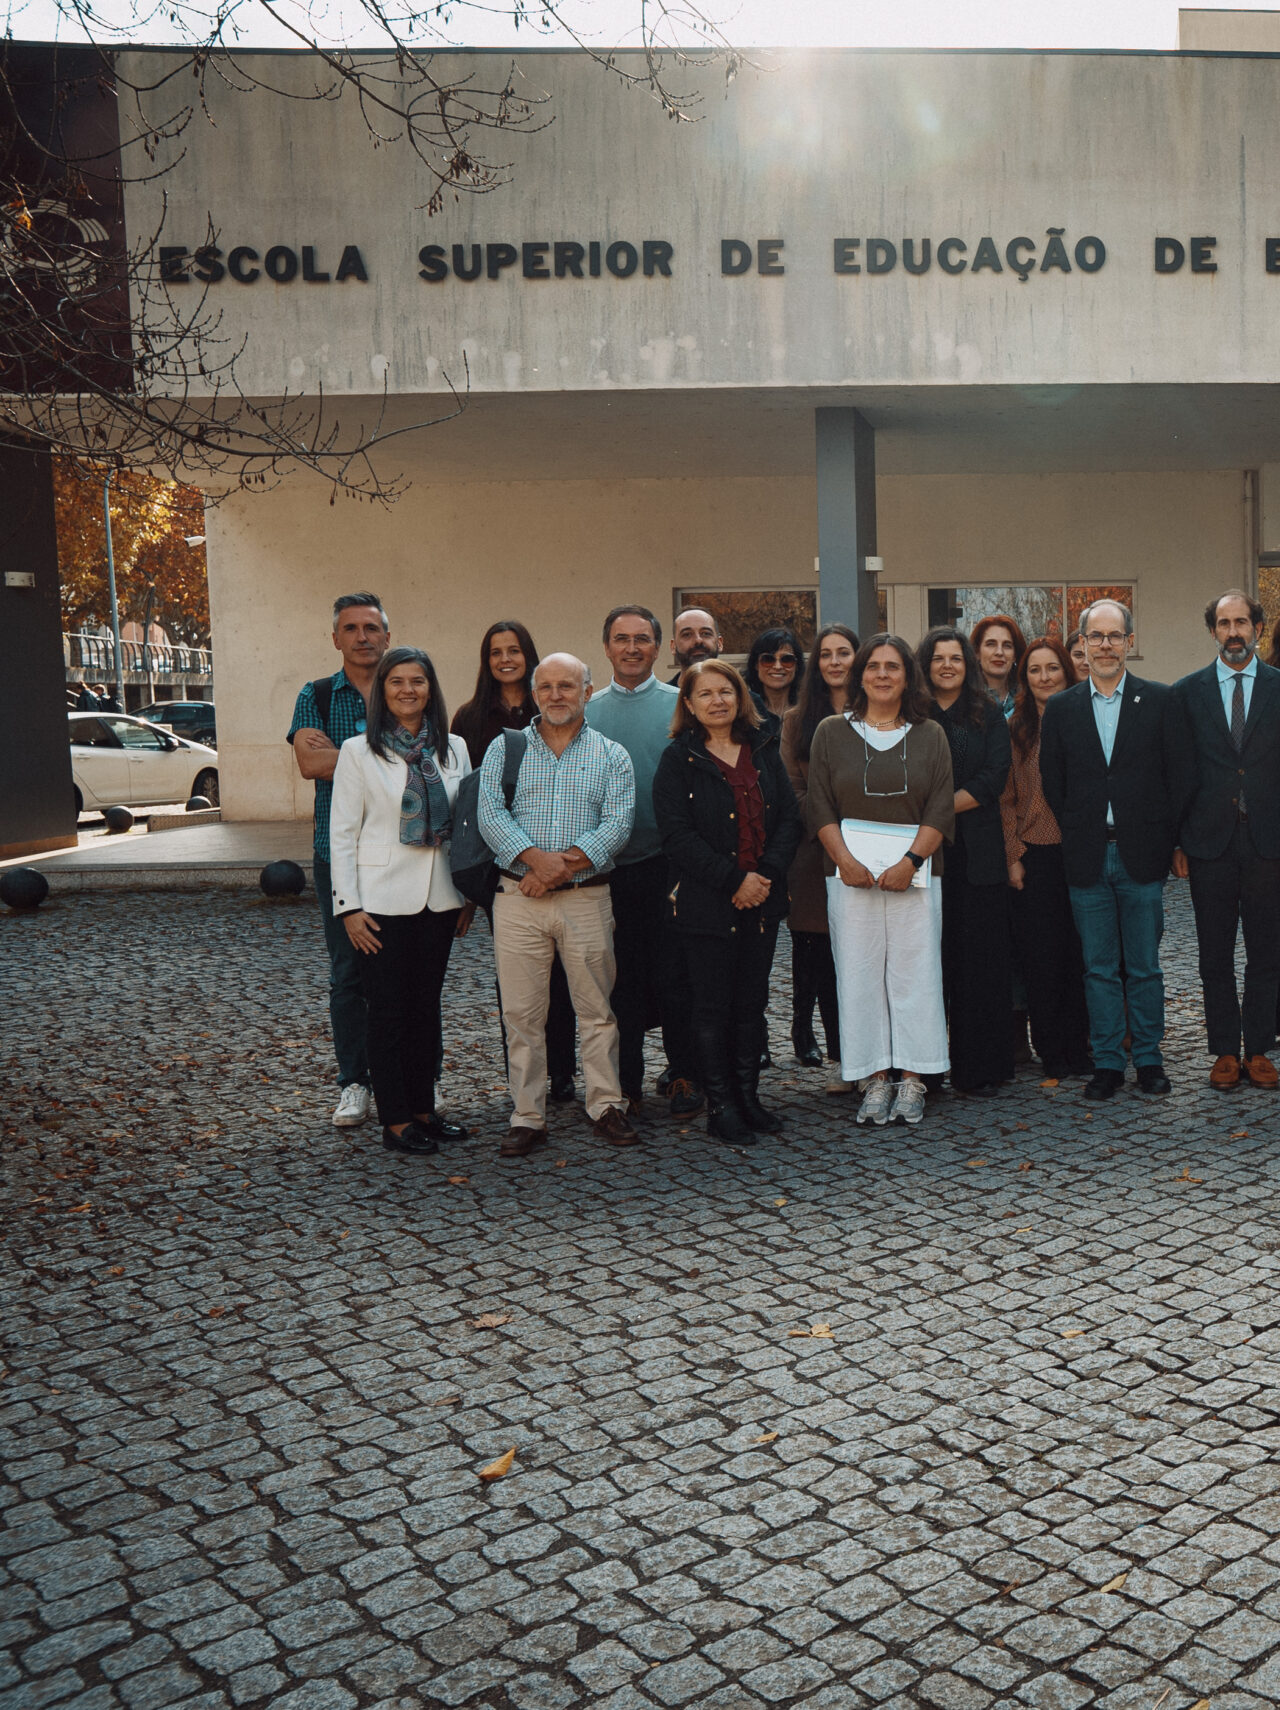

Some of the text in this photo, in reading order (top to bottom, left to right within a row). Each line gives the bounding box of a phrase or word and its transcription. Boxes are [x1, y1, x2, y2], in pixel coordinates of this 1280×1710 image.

[159, 244, 369, 283] ESCOLA
[418, 240, 674, 283] SUPERIOR
[721, 238, 786, 276] DE
[834, 227, 1108, 283] EDUCAÇÃO
[1154, 236, 1218, 273] DE
